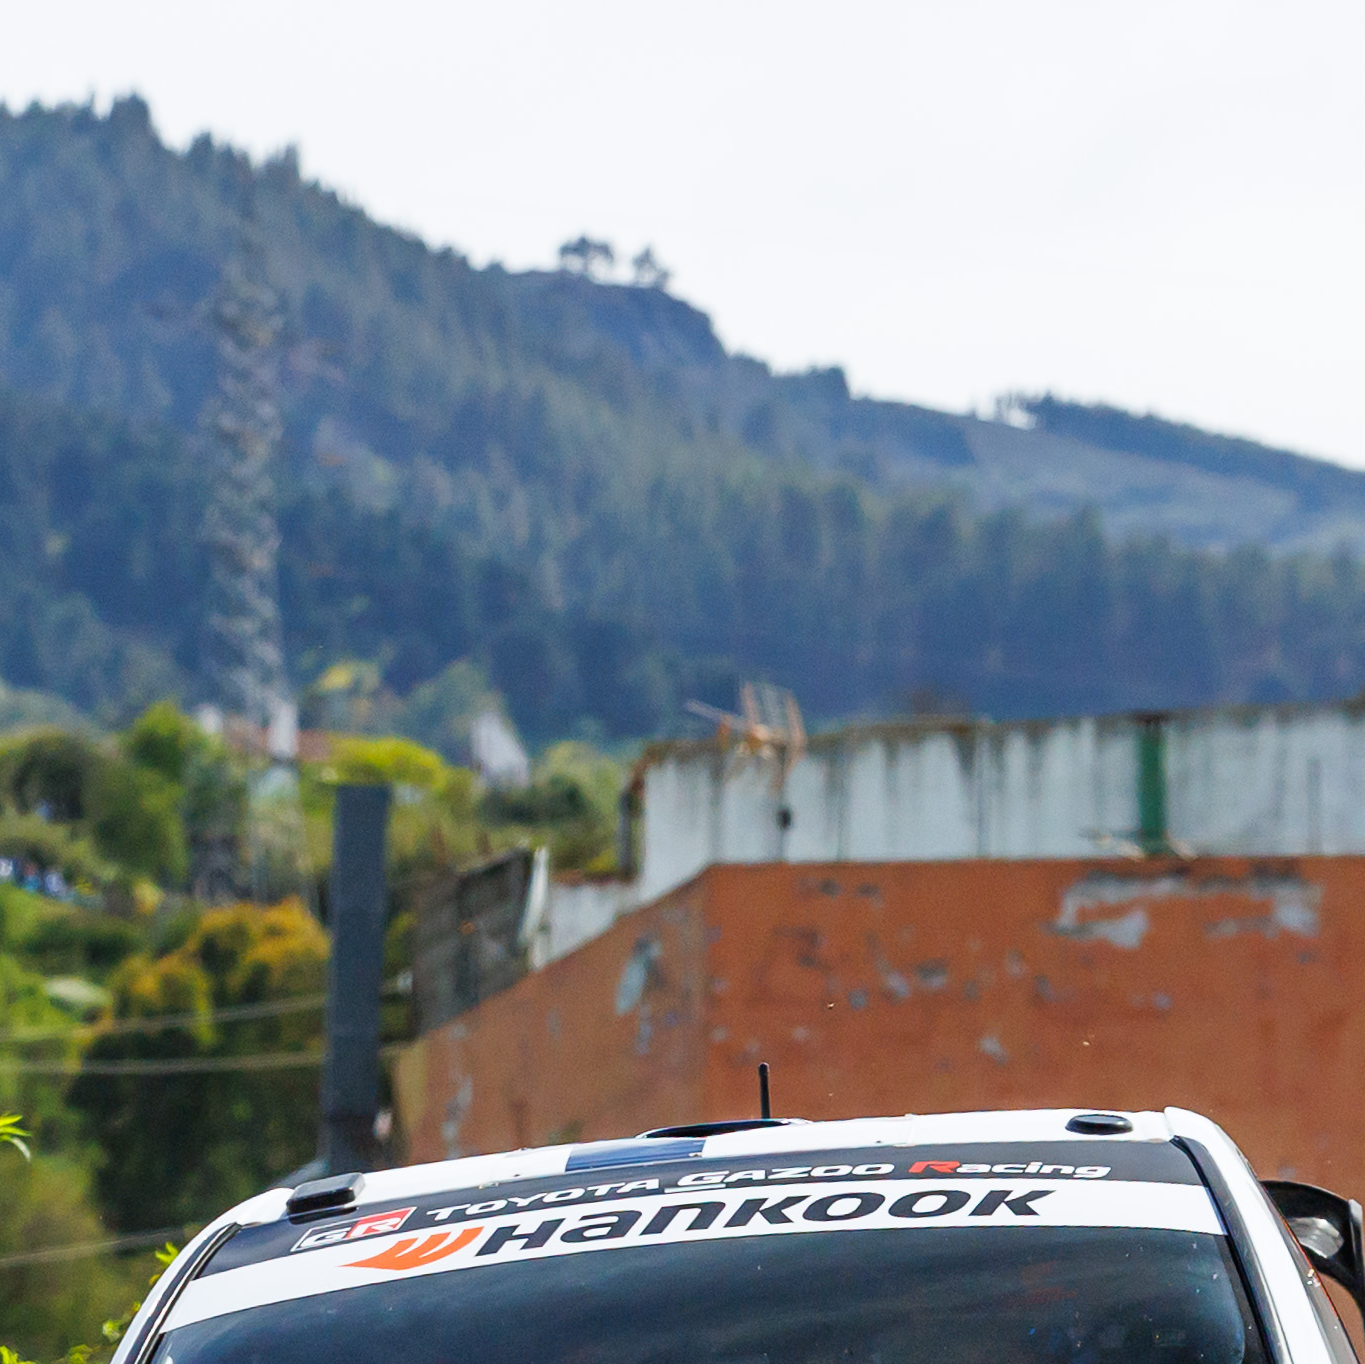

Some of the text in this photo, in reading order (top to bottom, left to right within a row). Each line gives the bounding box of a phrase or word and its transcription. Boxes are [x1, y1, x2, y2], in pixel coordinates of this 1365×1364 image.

[298, 1160, 1112, 1250] GR TOYOTA GAZOO Racing
